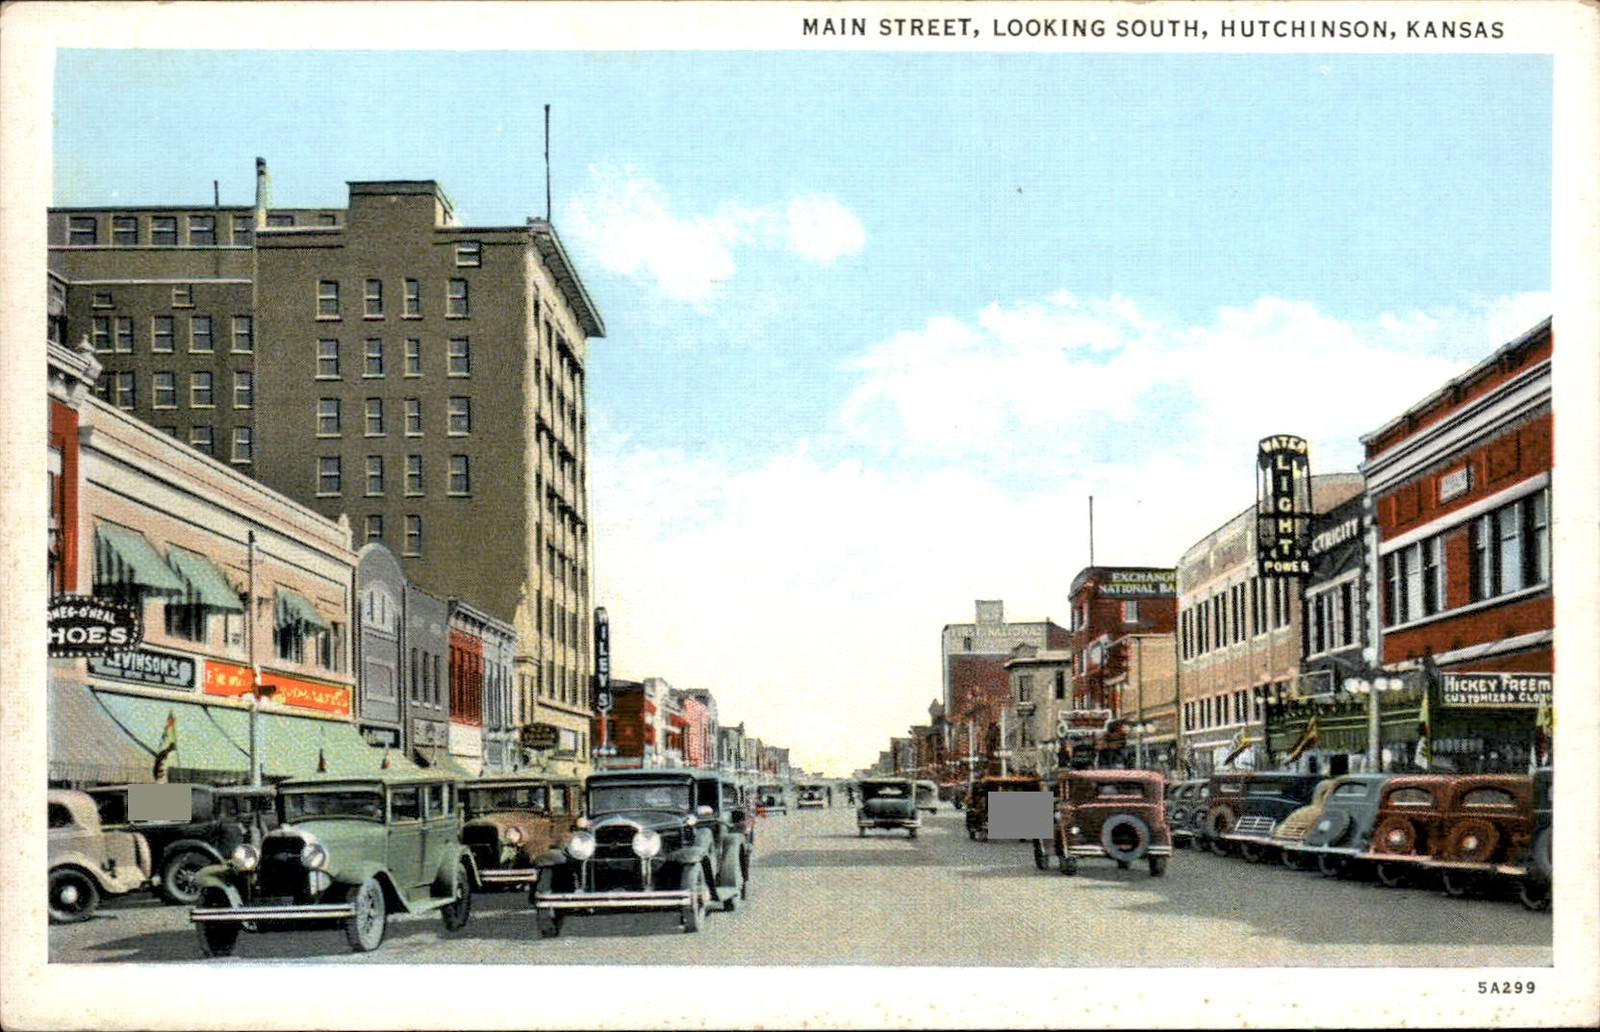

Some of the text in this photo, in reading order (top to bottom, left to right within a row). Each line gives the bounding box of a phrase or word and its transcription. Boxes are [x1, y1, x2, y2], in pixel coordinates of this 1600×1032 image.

[1278, 455, 1293, 556] LIGHT
[1264, 560, 1310, 573] POWER
[1443, 675, 1498, 692] HICKEY
[1477, 981, 1536, 994] 5A299
